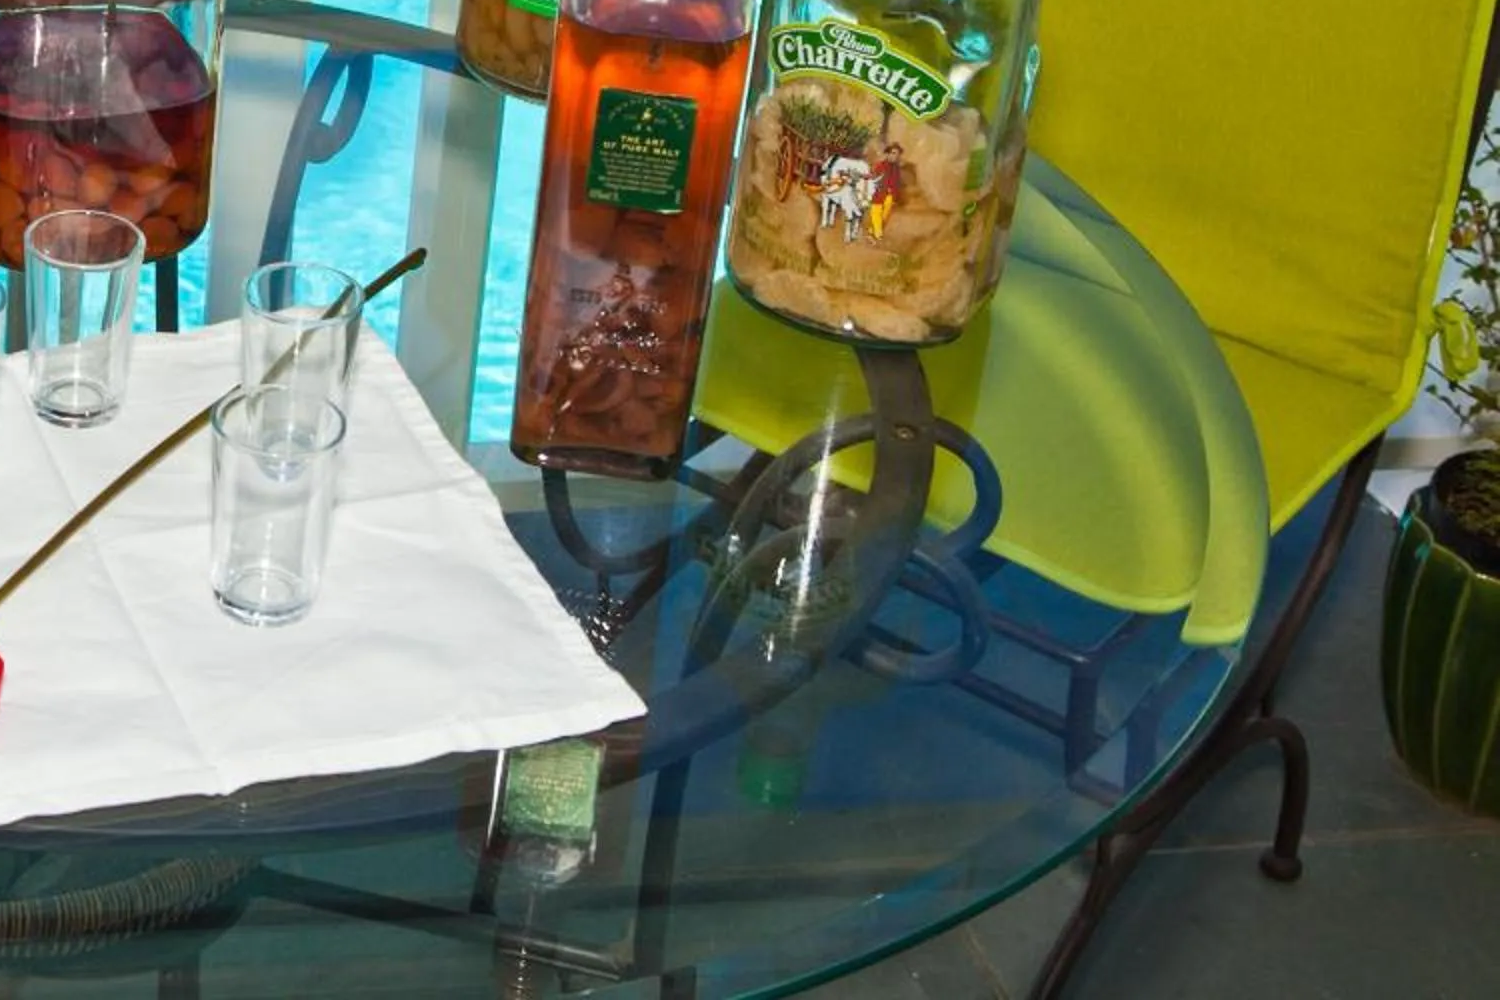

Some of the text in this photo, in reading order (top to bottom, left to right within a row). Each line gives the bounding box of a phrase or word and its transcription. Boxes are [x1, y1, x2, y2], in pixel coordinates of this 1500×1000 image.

[829, 24, 877, 54] Rhum
[778, 34, 933, 110] Charrette
[603, 141, 680, 157] OF PURE MALT
[621, 135, 665, 148] THE ART
